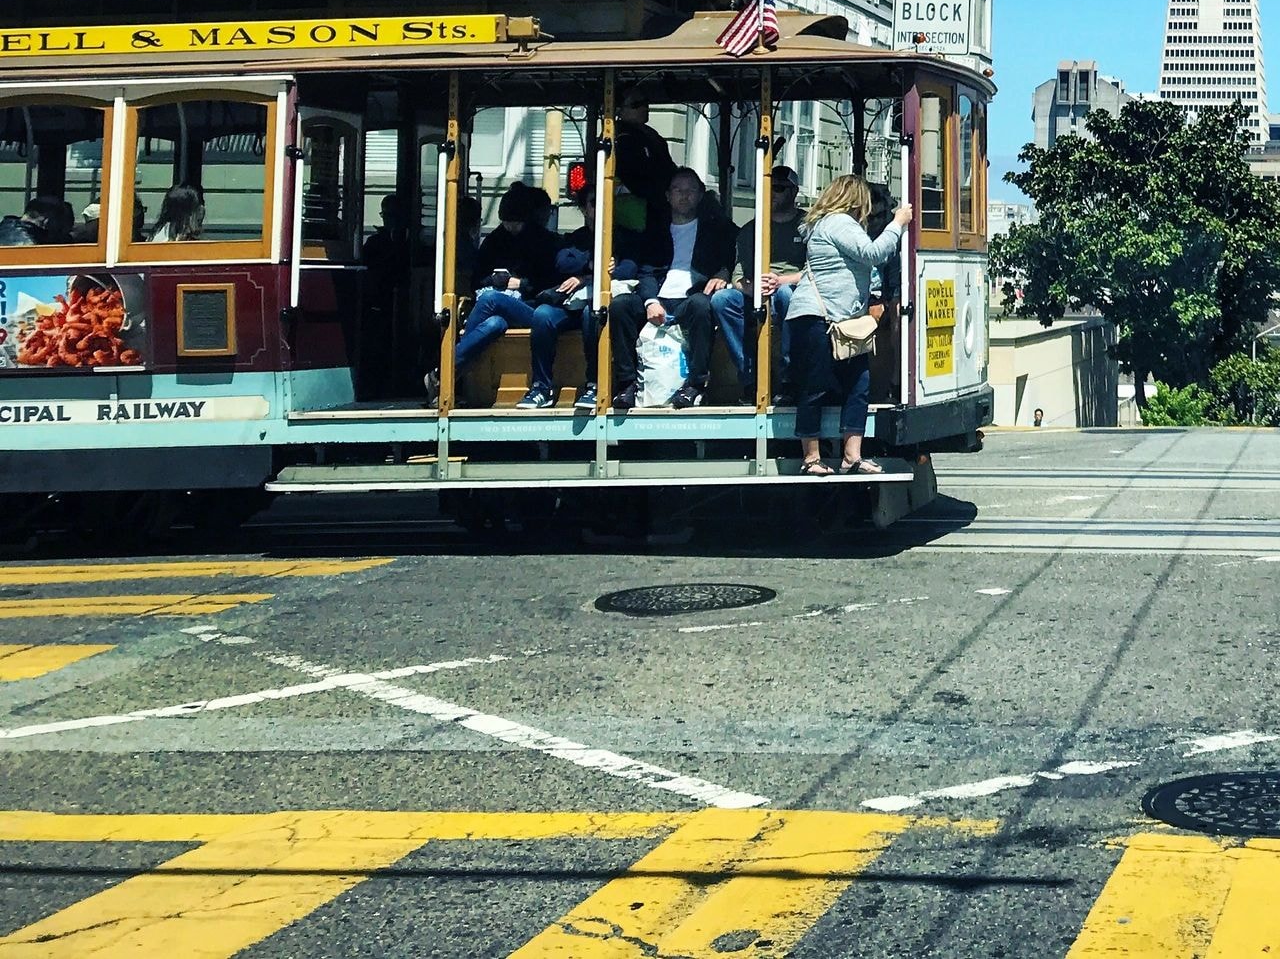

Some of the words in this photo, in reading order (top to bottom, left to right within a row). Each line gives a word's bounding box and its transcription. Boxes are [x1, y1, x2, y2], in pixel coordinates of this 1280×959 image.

[902, 2, 962, 21] BLOCK
[131, 29, 164, 49] &
[189, 23, 380, 47] MASON
[402, 21, 476, 40] Sts.
[897, 31, 965, 45] INTSECTION
[928, 287, 954, 299] POWELL
[935, 299, 948, 308] AND
[928, 307, 955, 320] MARKET
[97, 400, 207, 421] RAILWAY
